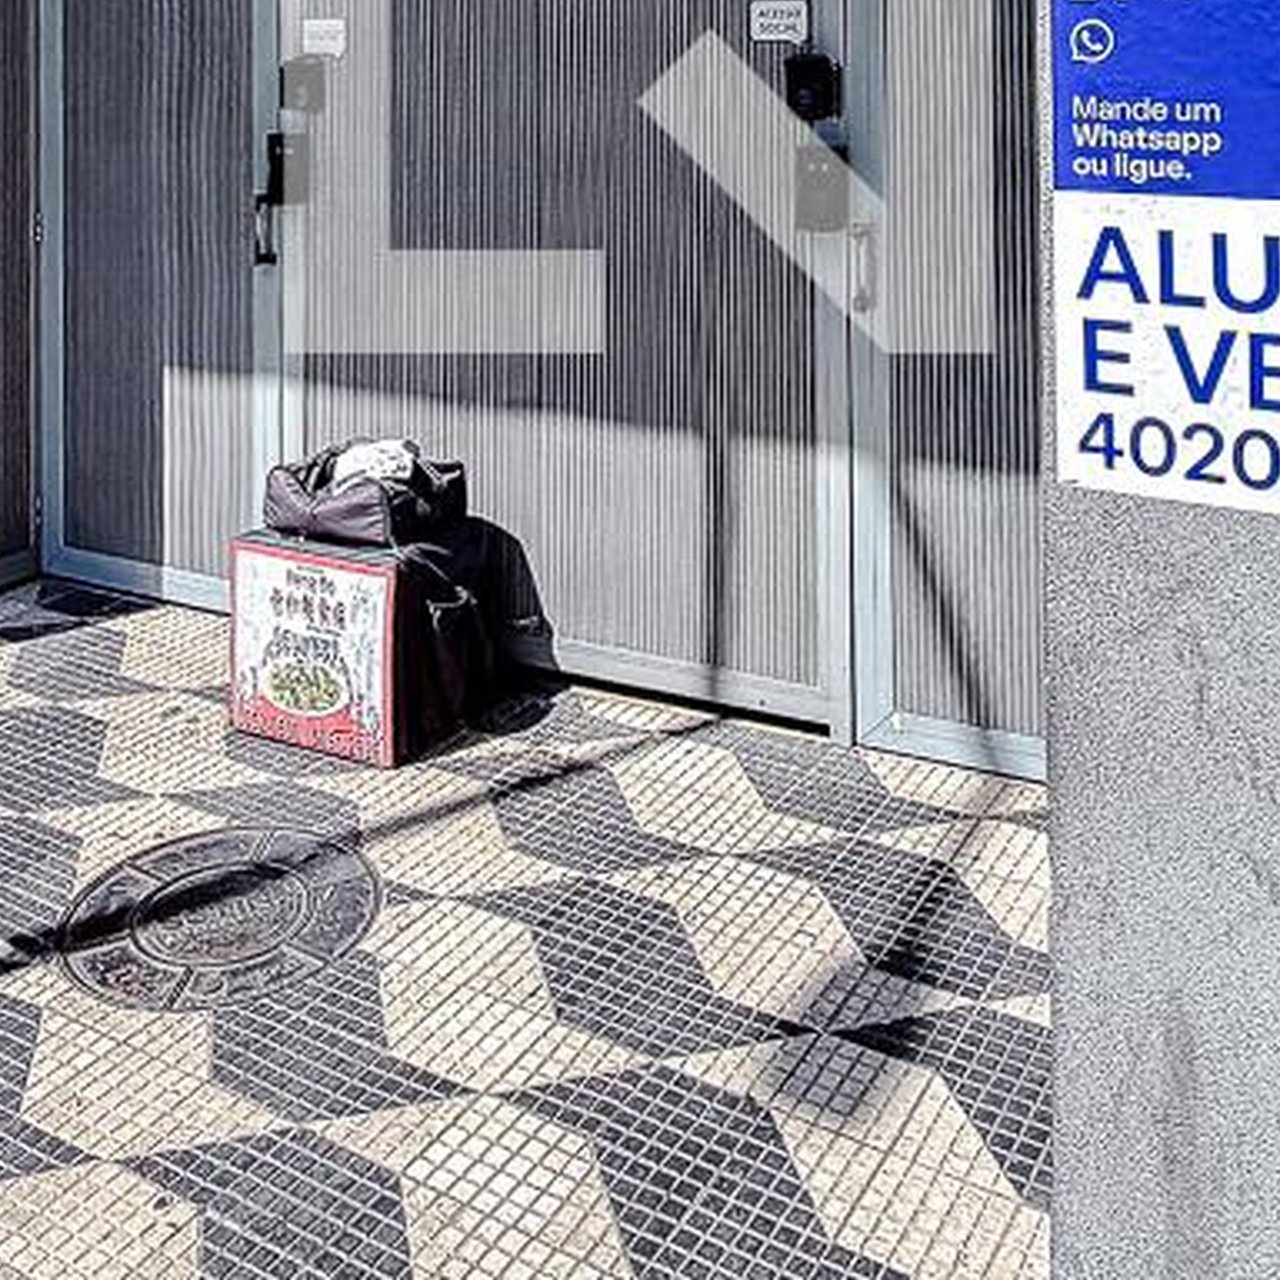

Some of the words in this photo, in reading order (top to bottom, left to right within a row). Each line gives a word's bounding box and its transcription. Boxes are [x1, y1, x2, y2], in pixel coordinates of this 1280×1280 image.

[1072, 95, 1168, 121] Mande
[1175, 102, 1221, 123] um
[1072, 123, 1222, 157] Whatsapp
[1072, 157, 1108, 176] ou
[1114, 152, 1192, 184] ligue.
[1082, 317, 1135, 397] E
